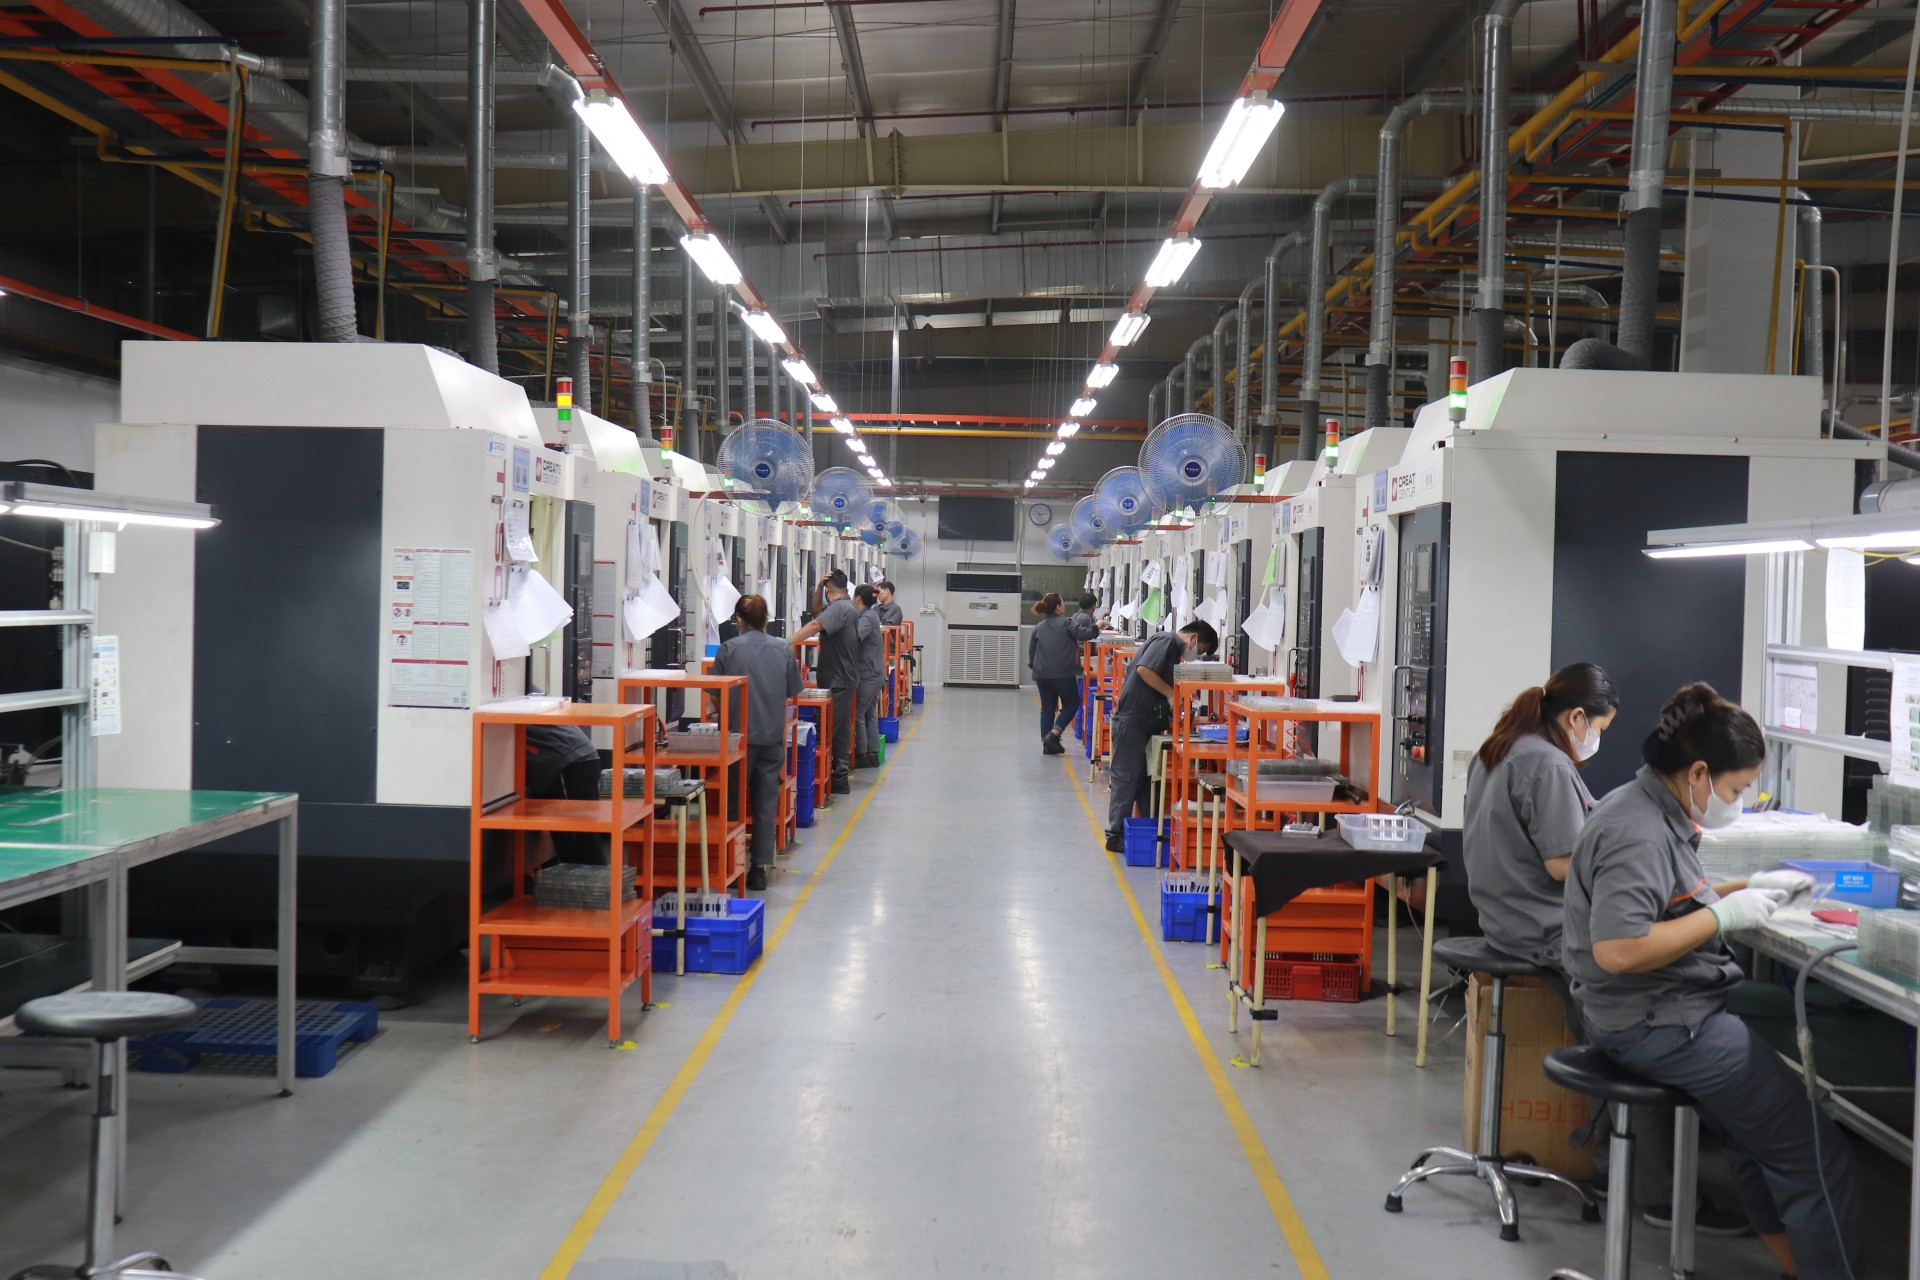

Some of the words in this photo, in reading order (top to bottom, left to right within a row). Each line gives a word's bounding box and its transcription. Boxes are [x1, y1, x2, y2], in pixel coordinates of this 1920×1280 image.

[1398, 472, 1416, 488] CREAT
[1398, 486, 1416, 500] CENTUR
[1502, 1100, 1591, 1124] CTECH
